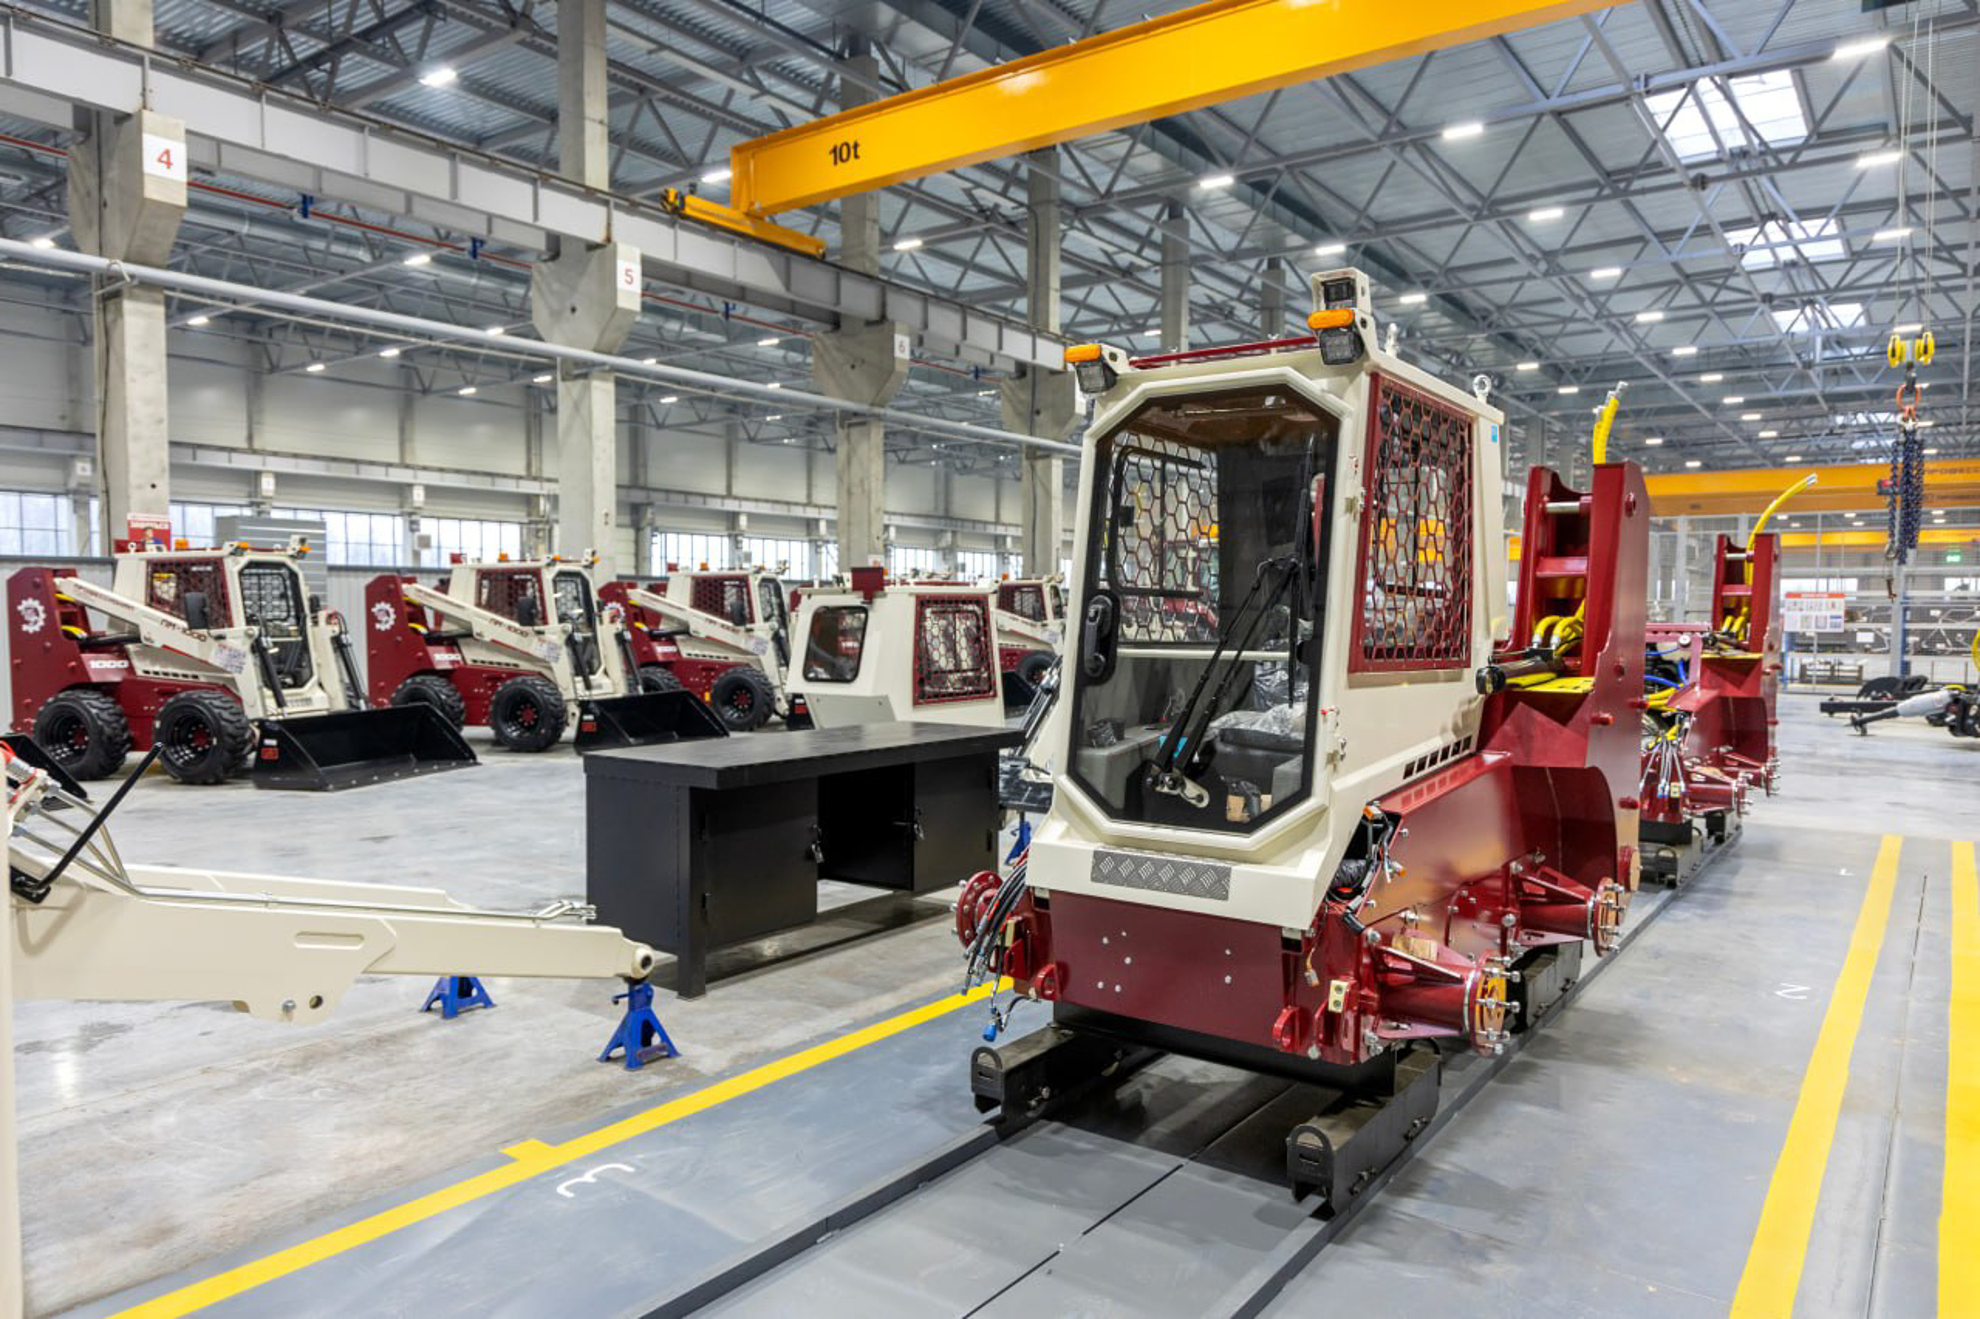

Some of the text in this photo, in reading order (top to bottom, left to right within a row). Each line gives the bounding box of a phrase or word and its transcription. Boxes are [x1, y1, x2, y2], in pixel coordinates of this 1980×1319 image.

[157, 149, 174, 170] 4
[828, 140, 861, 167] 10t
[624, 268, 634, 285] 5
[89, 659, 129, 669] 1000
